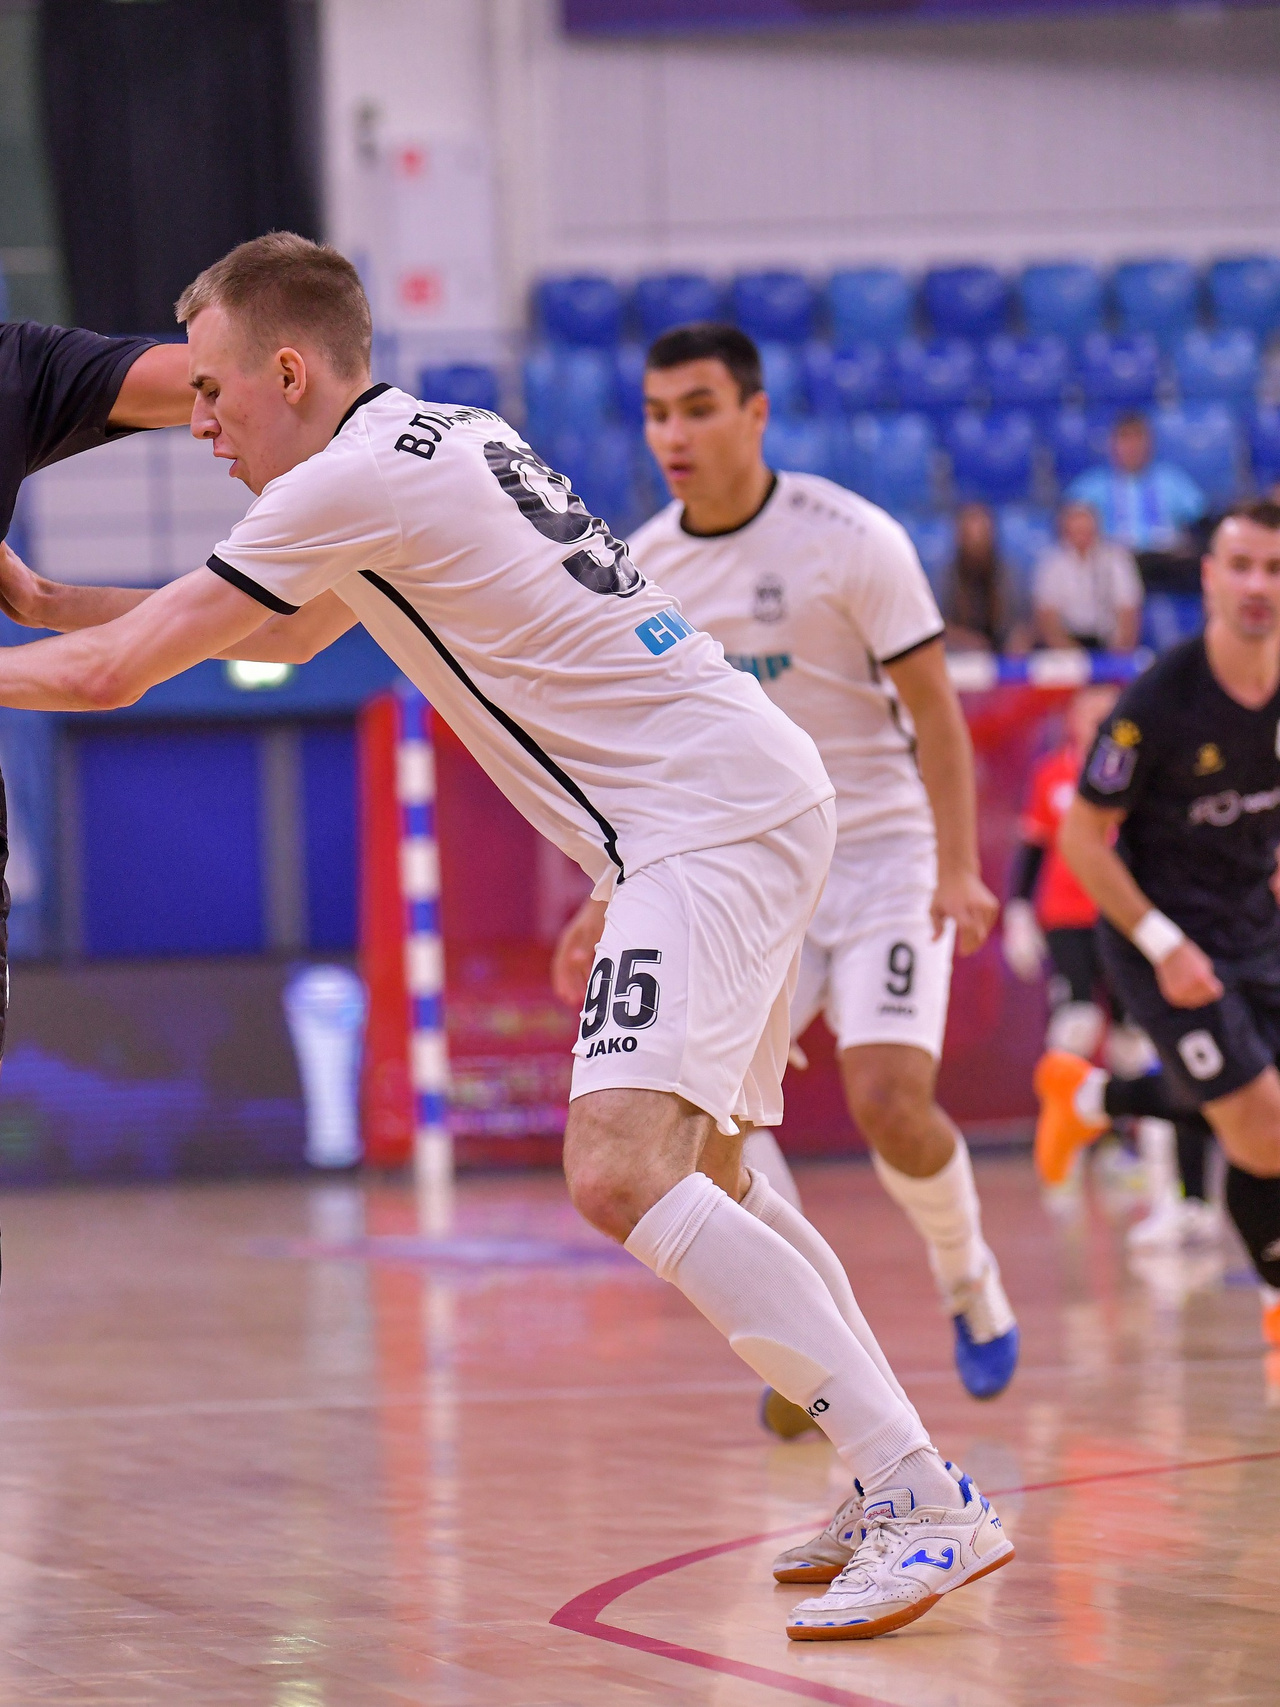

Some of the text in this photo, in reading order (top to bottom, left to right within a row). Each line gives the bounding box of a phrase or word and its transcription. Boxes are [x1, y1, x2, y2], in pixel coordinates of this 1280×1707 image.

[580, 948, 662, 1041] 95
[885, 942, 915, 997] 9
[586, 1036, 638, 1059] JAKO
